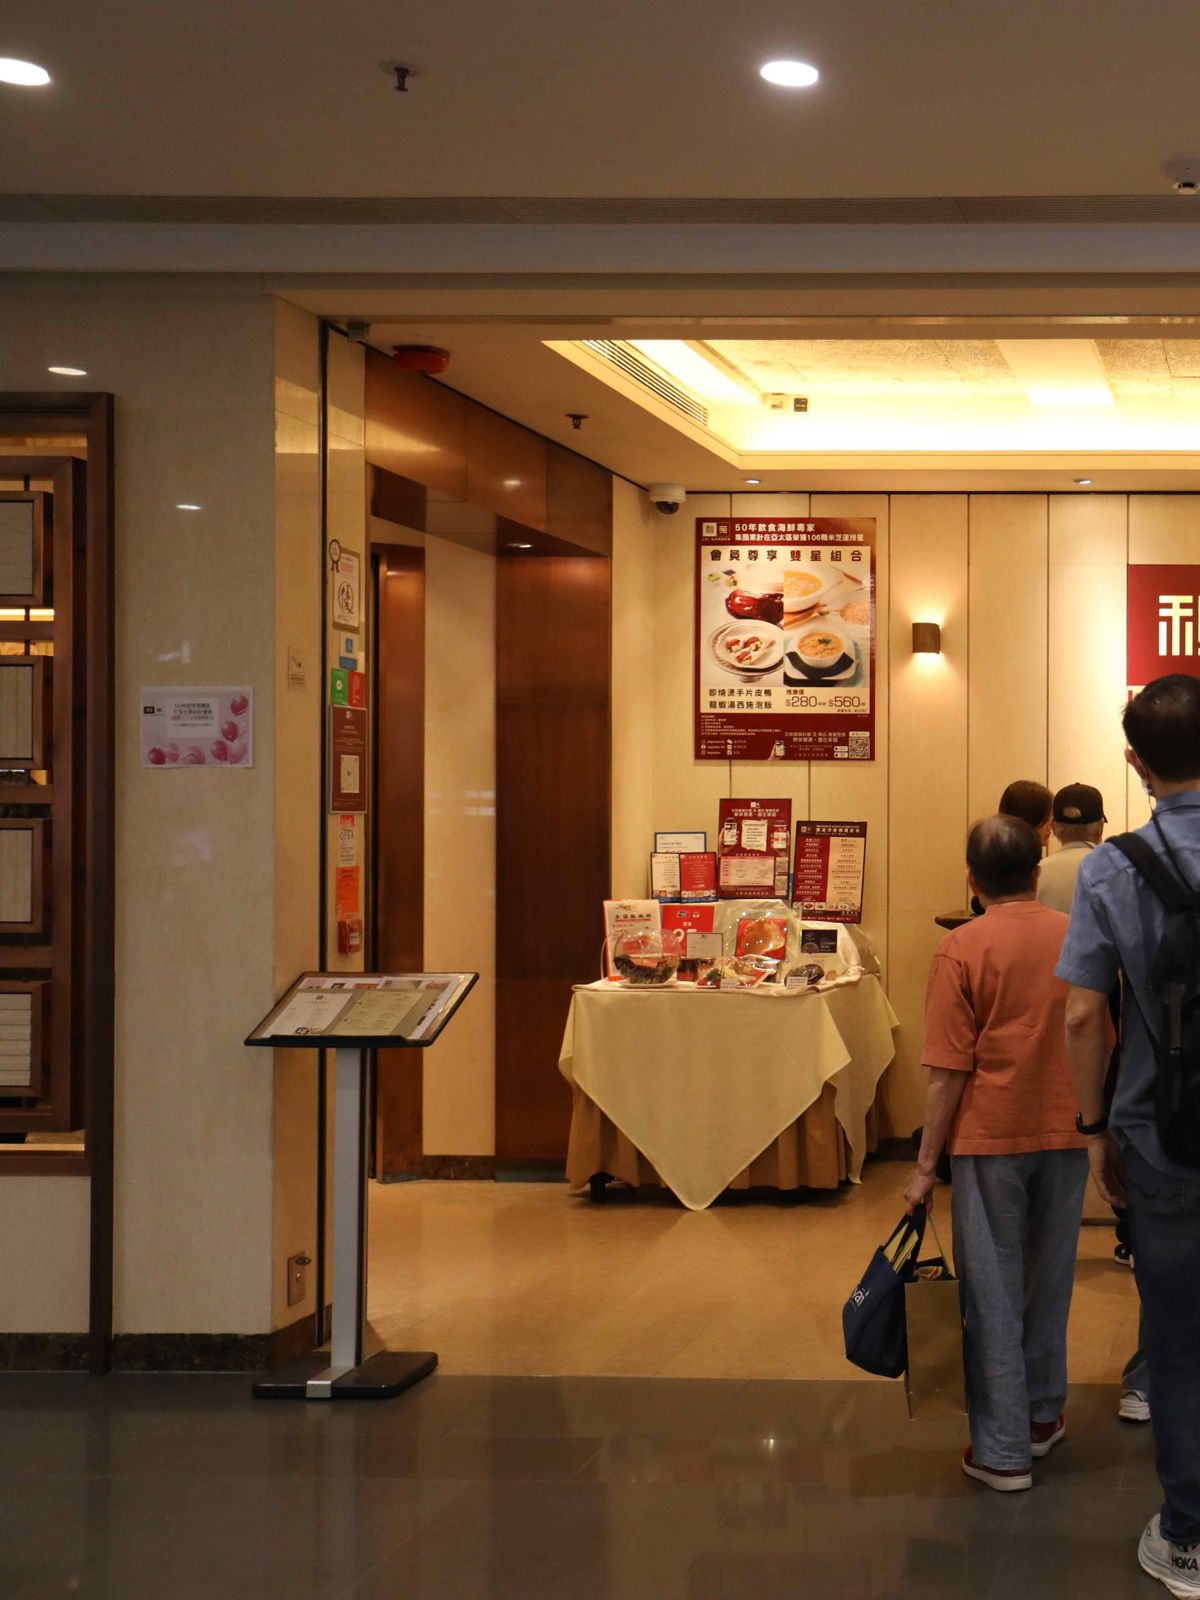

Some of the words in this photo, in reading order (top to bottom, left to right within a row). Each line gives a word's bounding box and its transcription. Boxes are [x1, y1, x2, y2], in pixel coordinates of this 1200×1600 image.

[785, 696, 818, 708] $280
[828, 696, 861, 708] $560
[1172, 1555, 1198, 1571] HOKA
